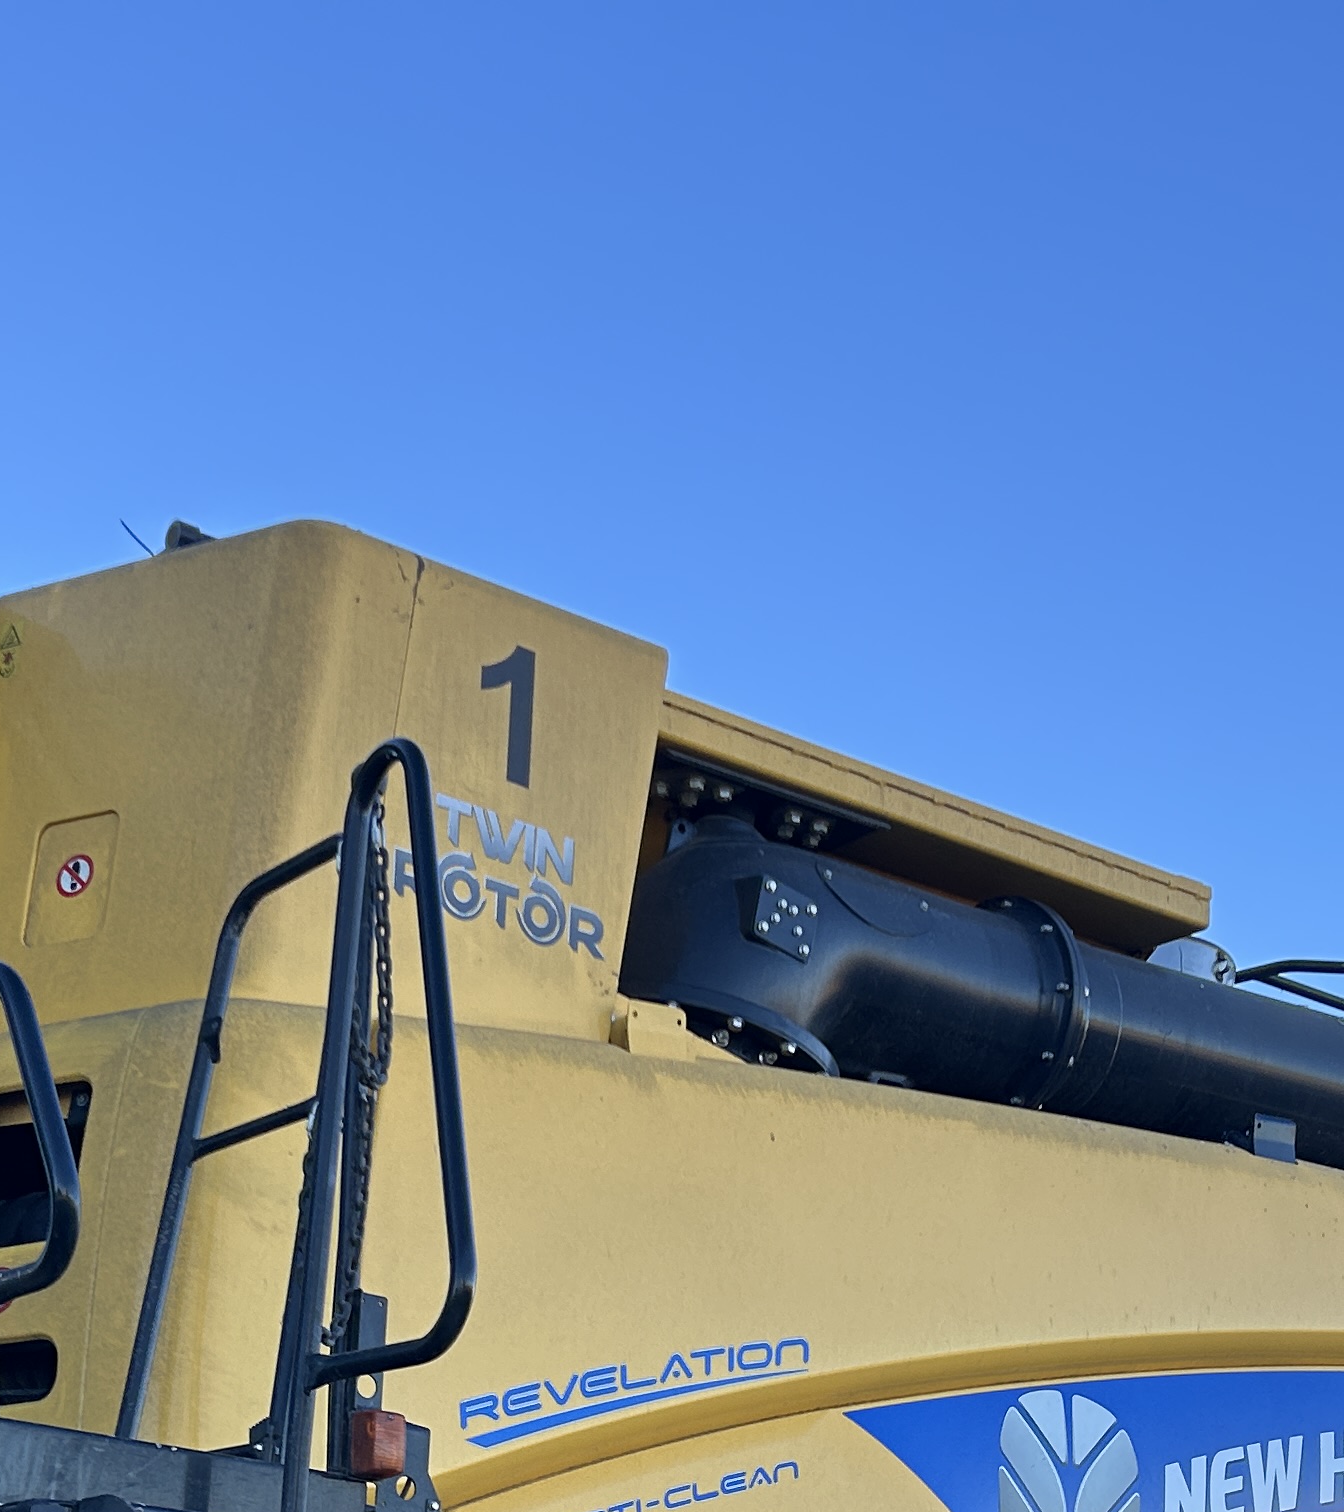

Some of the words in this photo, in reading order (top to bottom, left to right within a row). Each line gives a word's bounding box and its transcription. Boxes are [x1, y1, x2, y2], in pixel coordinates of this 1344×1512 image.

[480, 645, 536, 789] 1
[436, 792, 576, 887] TWIN
[459, 1336, 810, 1430] REVELATION
